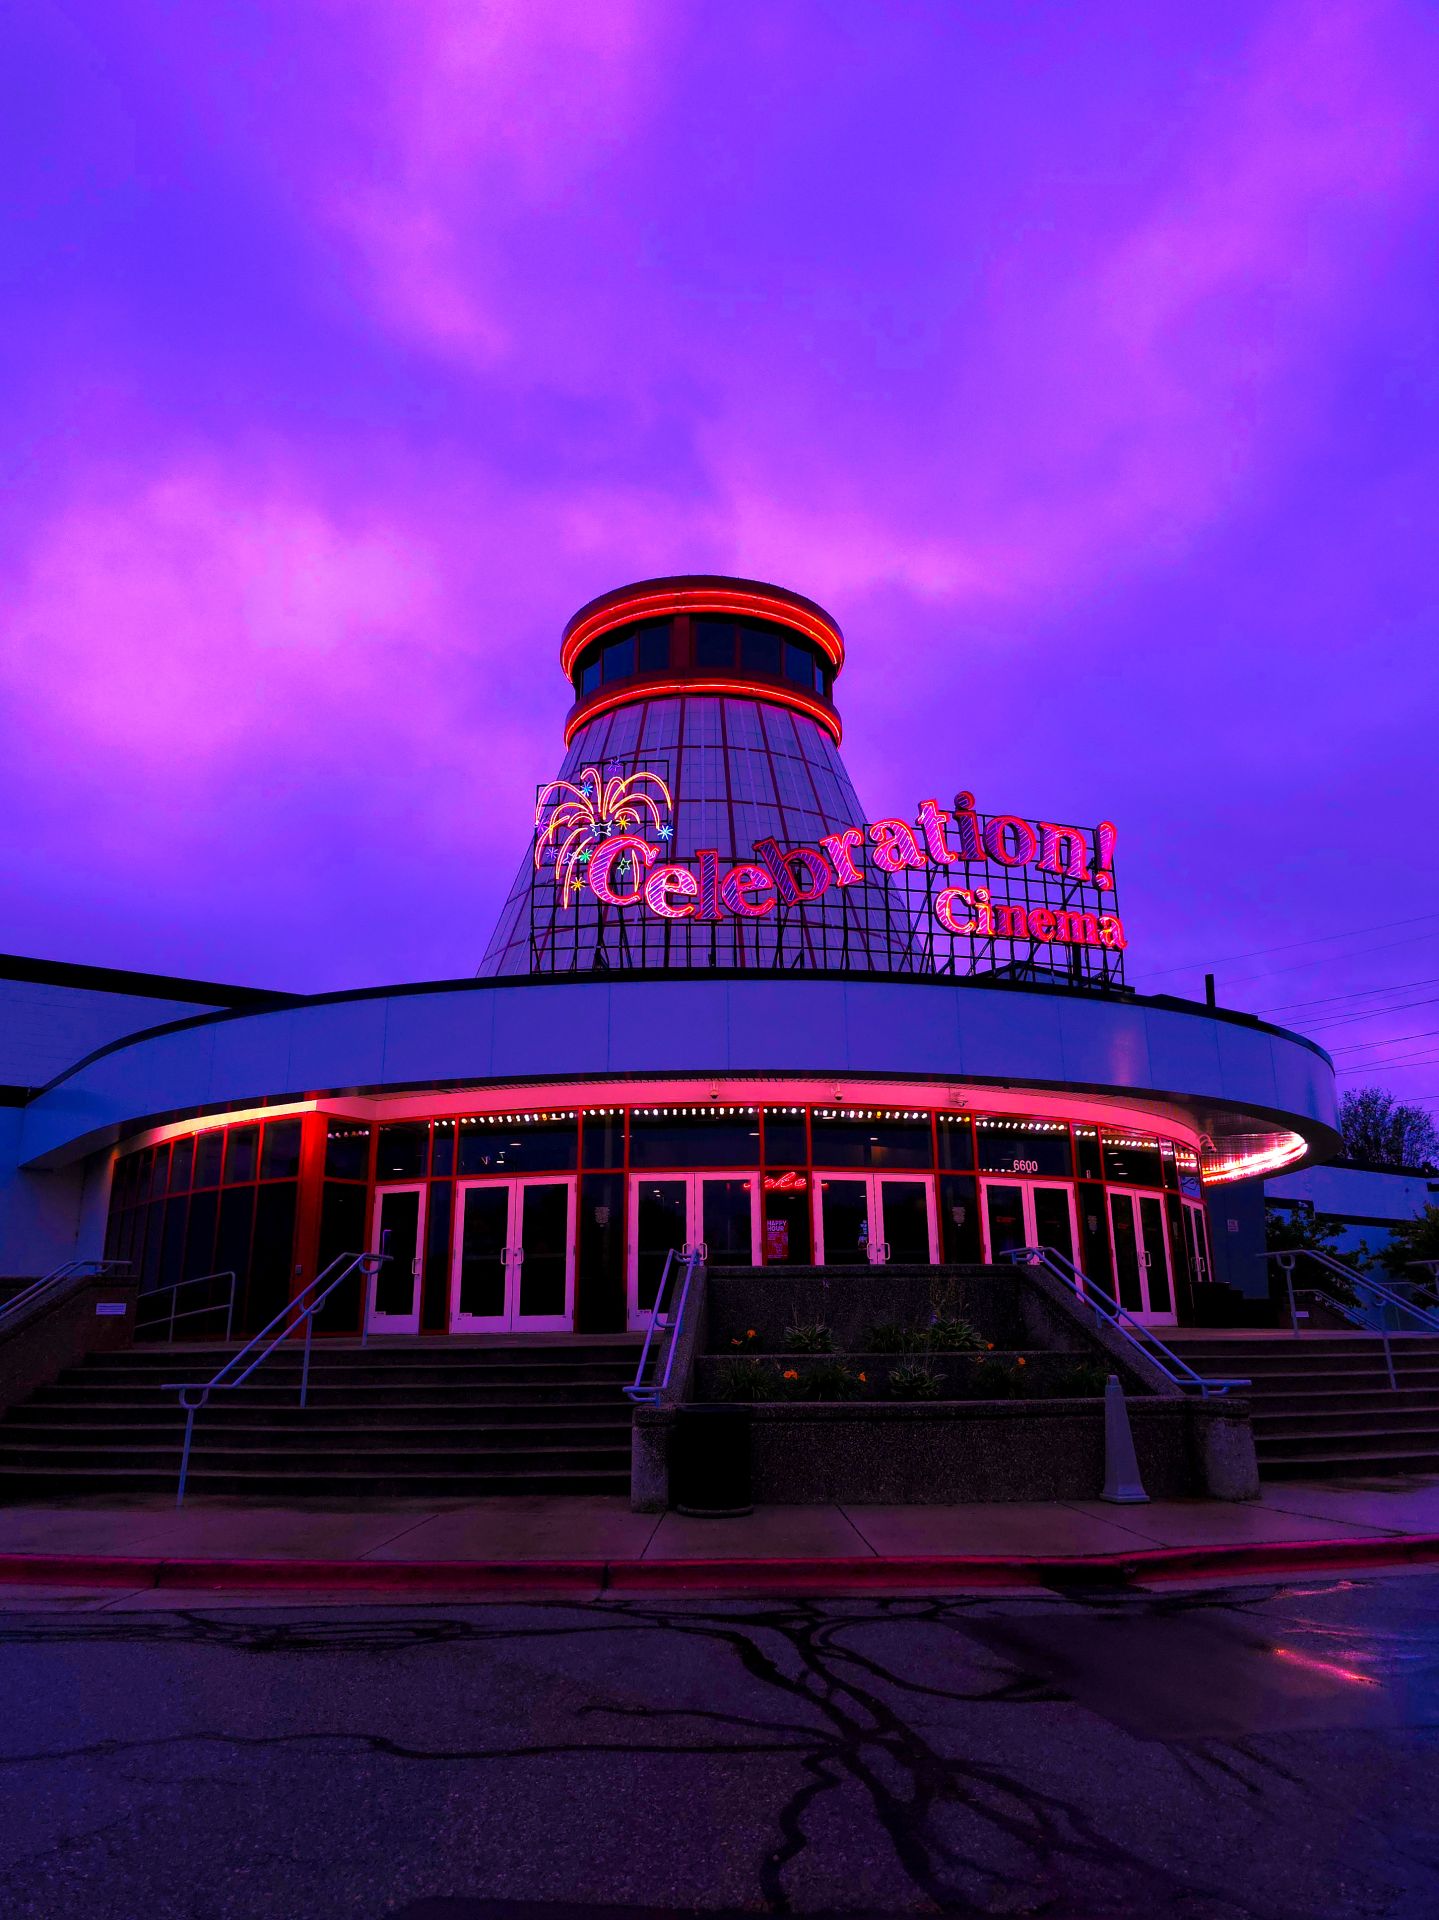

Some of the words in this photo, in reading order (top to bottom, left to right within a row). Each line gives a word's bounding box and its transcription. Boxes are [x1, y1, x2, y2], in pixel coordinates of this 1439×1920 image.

[588, 790, 1118, 922] Celebration!
[933, 886, 1128, 949] Cinema
[1013, 1159, 1038, 1172] 6600
